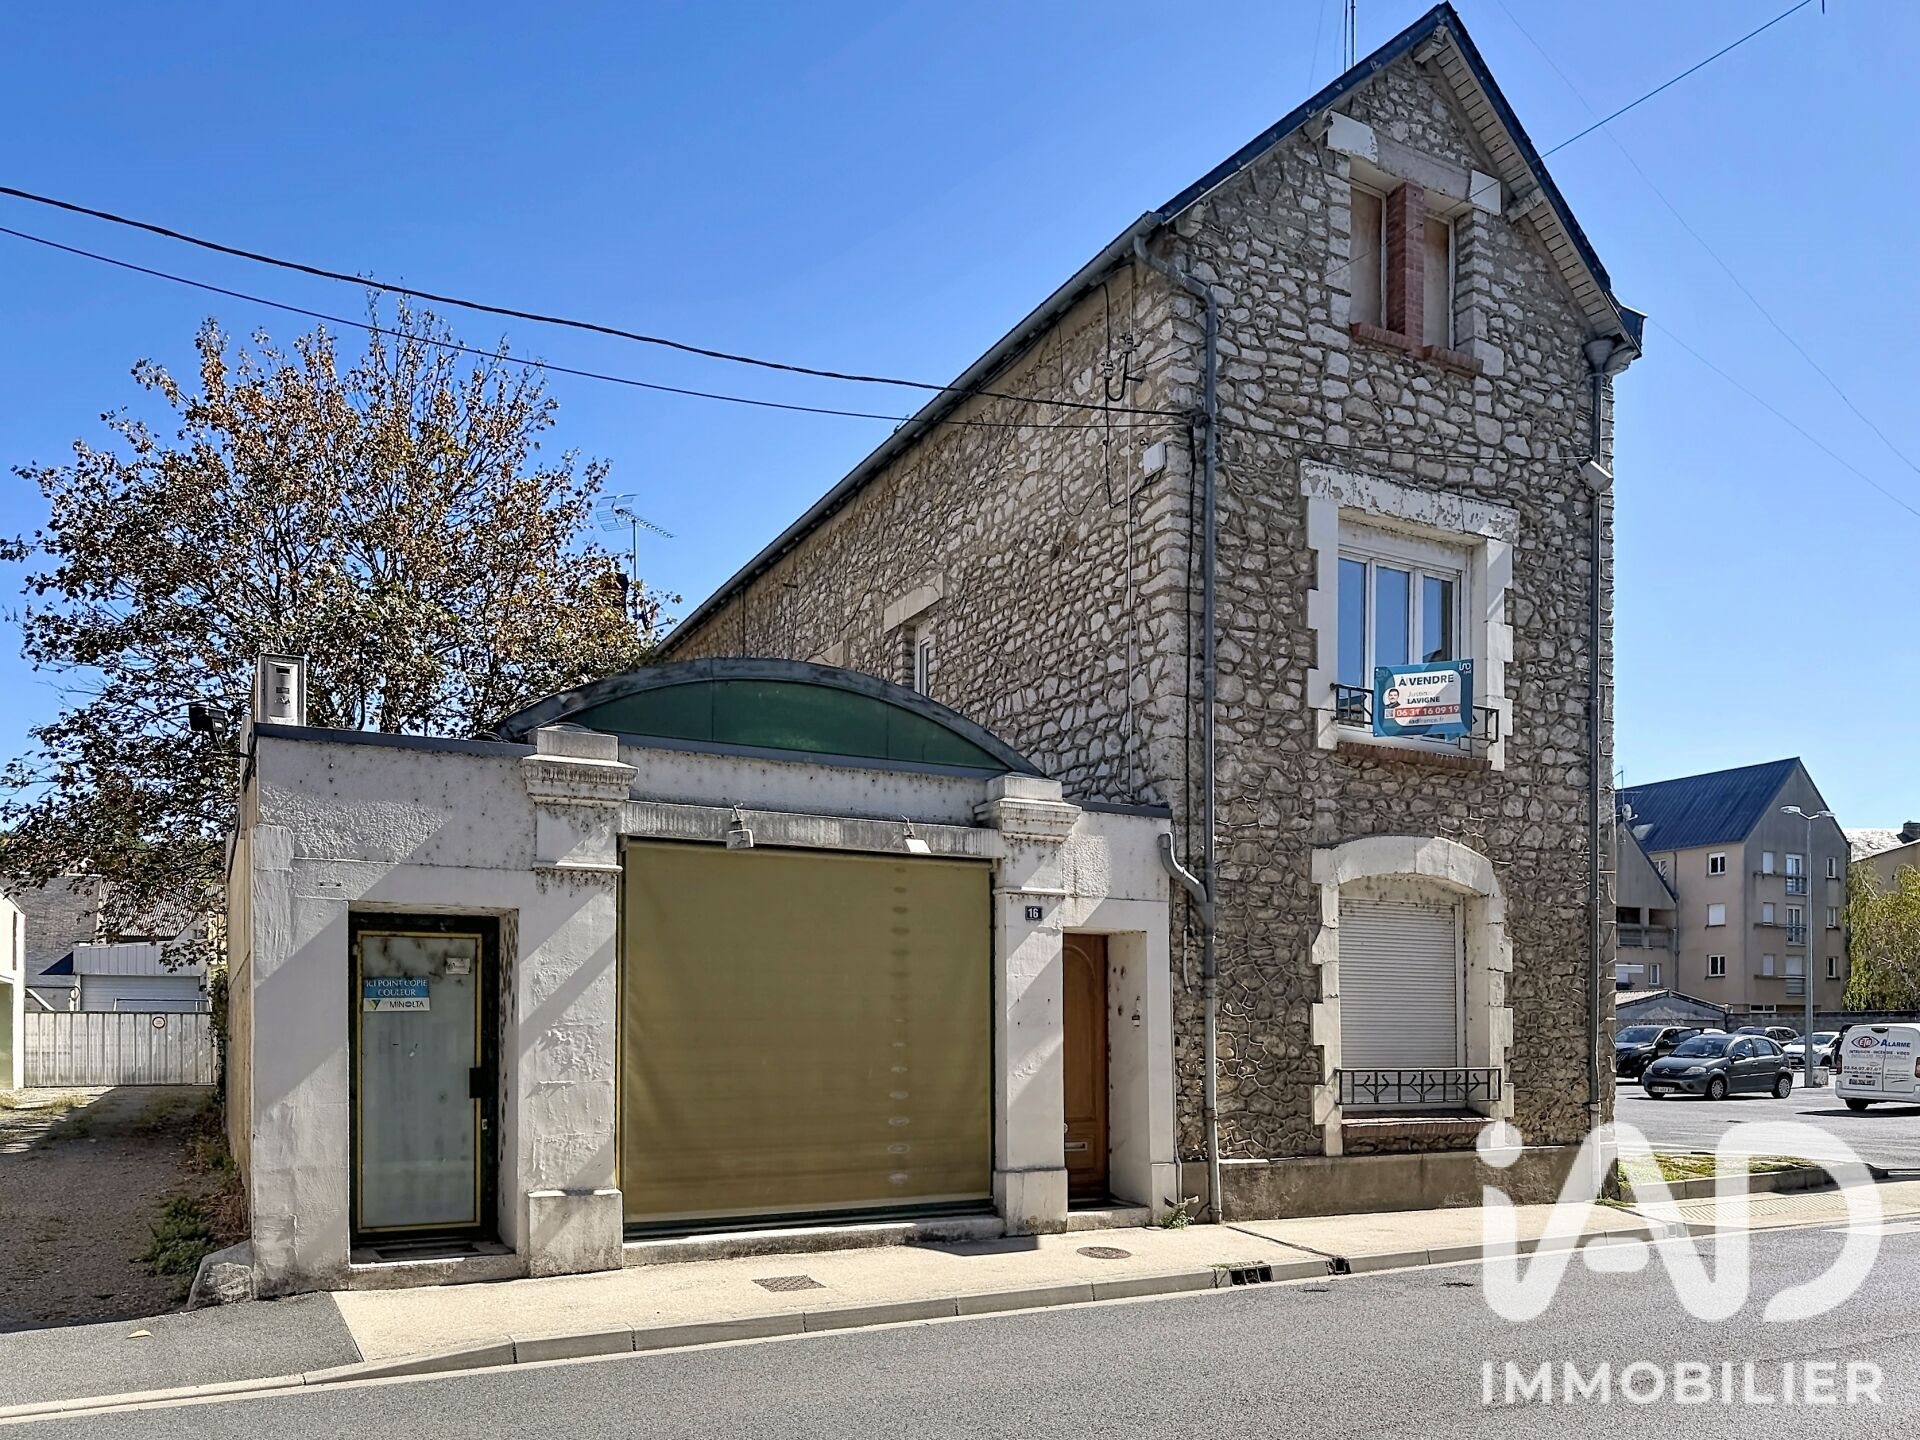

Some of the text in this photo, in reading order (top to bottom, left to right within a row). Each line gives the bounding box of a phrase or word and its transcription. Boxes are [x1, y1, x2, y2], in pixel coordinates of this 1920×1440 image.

[1399, 674, 1454, 686] À VENDRE
[1407, 696, 1440, 704] LAVIGNE
[1396, 709, 1408, 717] 06
[1423, 707, 1433, 715] 16
[1435, 706, 1446, 714] 09
[1448, 705, 1459, 713] 19
[1028, 908, 1039, 918] 16
[366, 979, 428, 987] ICI POINT COPIE
[377, 988, 416, 996] COULEUR
[1880, 1039, 1911, 1048] ALARME
